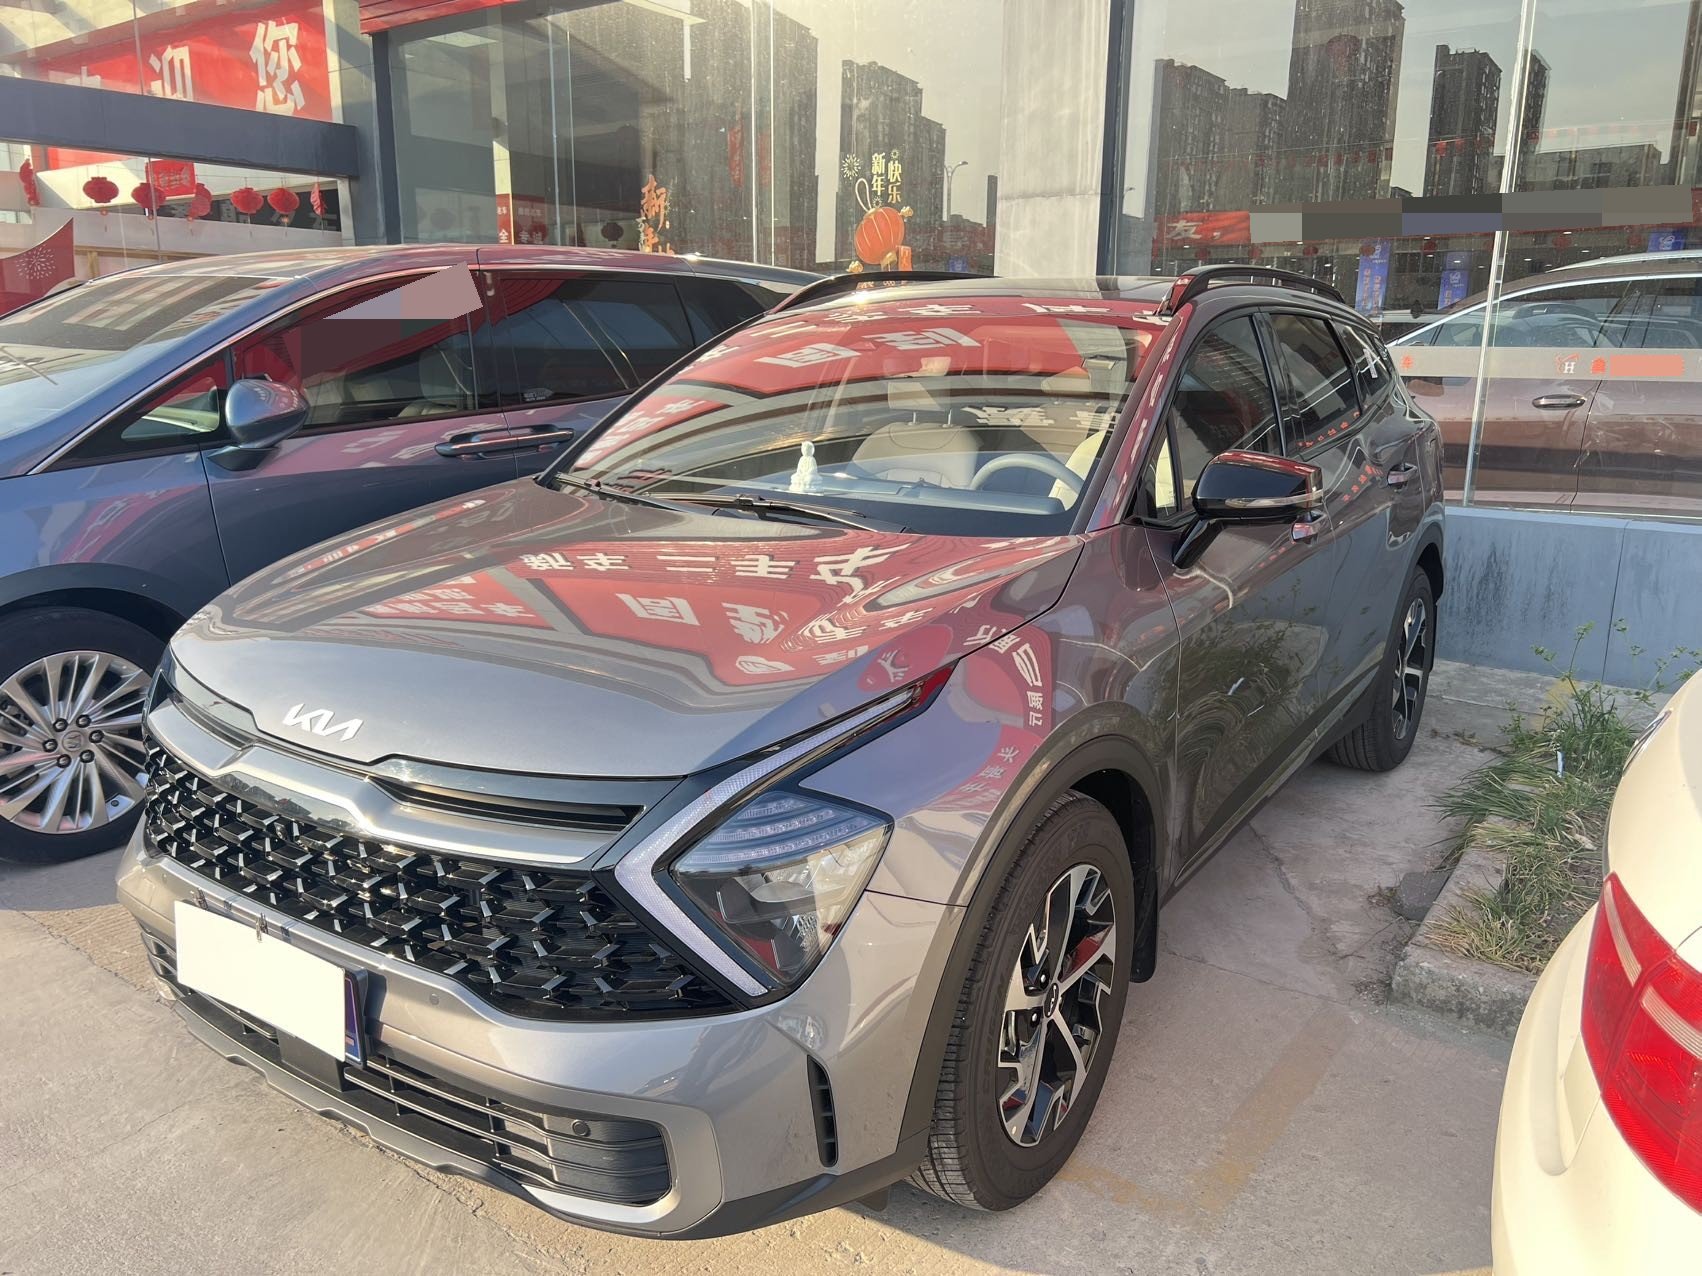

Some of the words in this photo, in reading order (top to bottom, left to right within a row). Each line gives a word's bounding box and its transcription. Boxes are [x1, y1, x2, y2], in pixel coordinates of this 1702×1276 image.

[871, 152, 885, 196] 新年
[887, 160, 902, 204] 快乐
[282, 703, 364, 742] KIA
